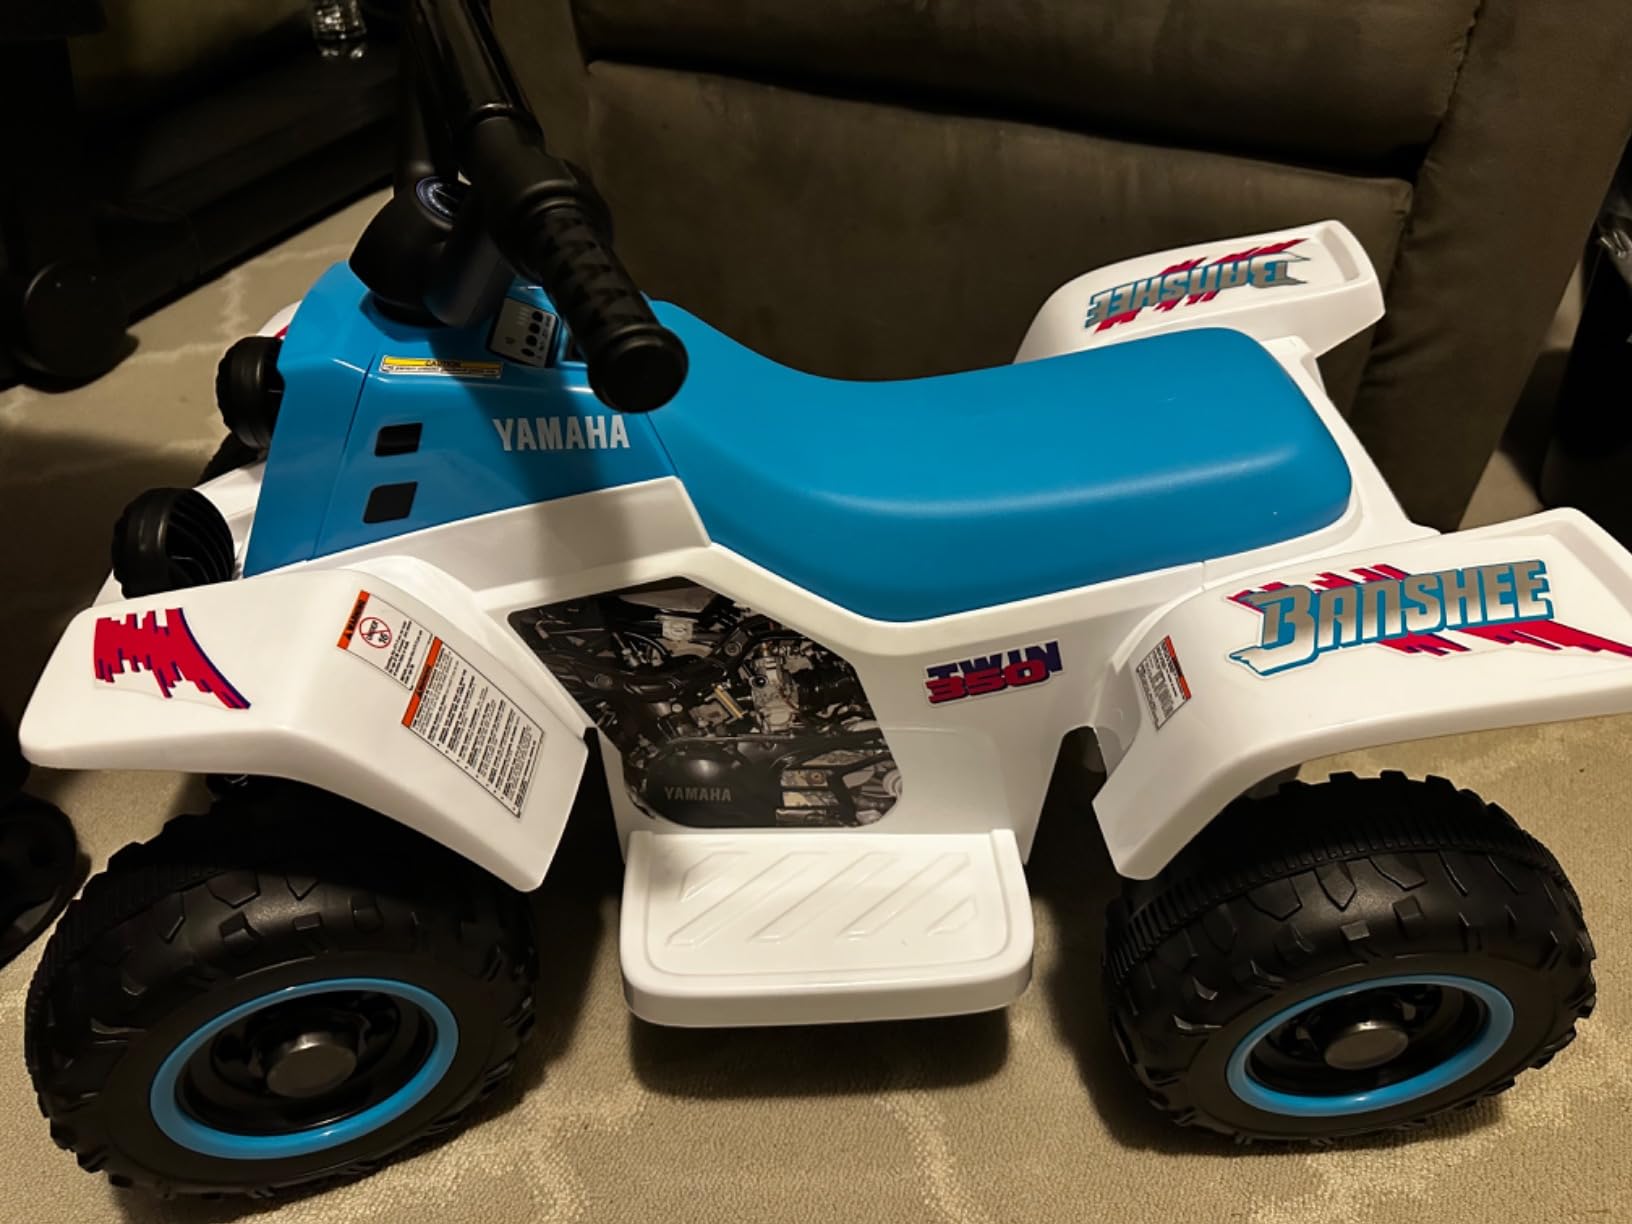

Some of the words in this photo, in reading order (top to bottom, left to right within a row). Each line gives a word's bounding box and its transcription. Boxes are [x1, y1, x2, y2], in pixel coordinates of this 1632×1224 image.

[1085, 251, 1311, 329] BANSHEE
[492, 414, 631, 451] YAMAHA
[1227, 559, 1555, 677] BANSHEE
[925, 659, 1050, 704] 350
[664, 785, 732, 802] YAMAHA
